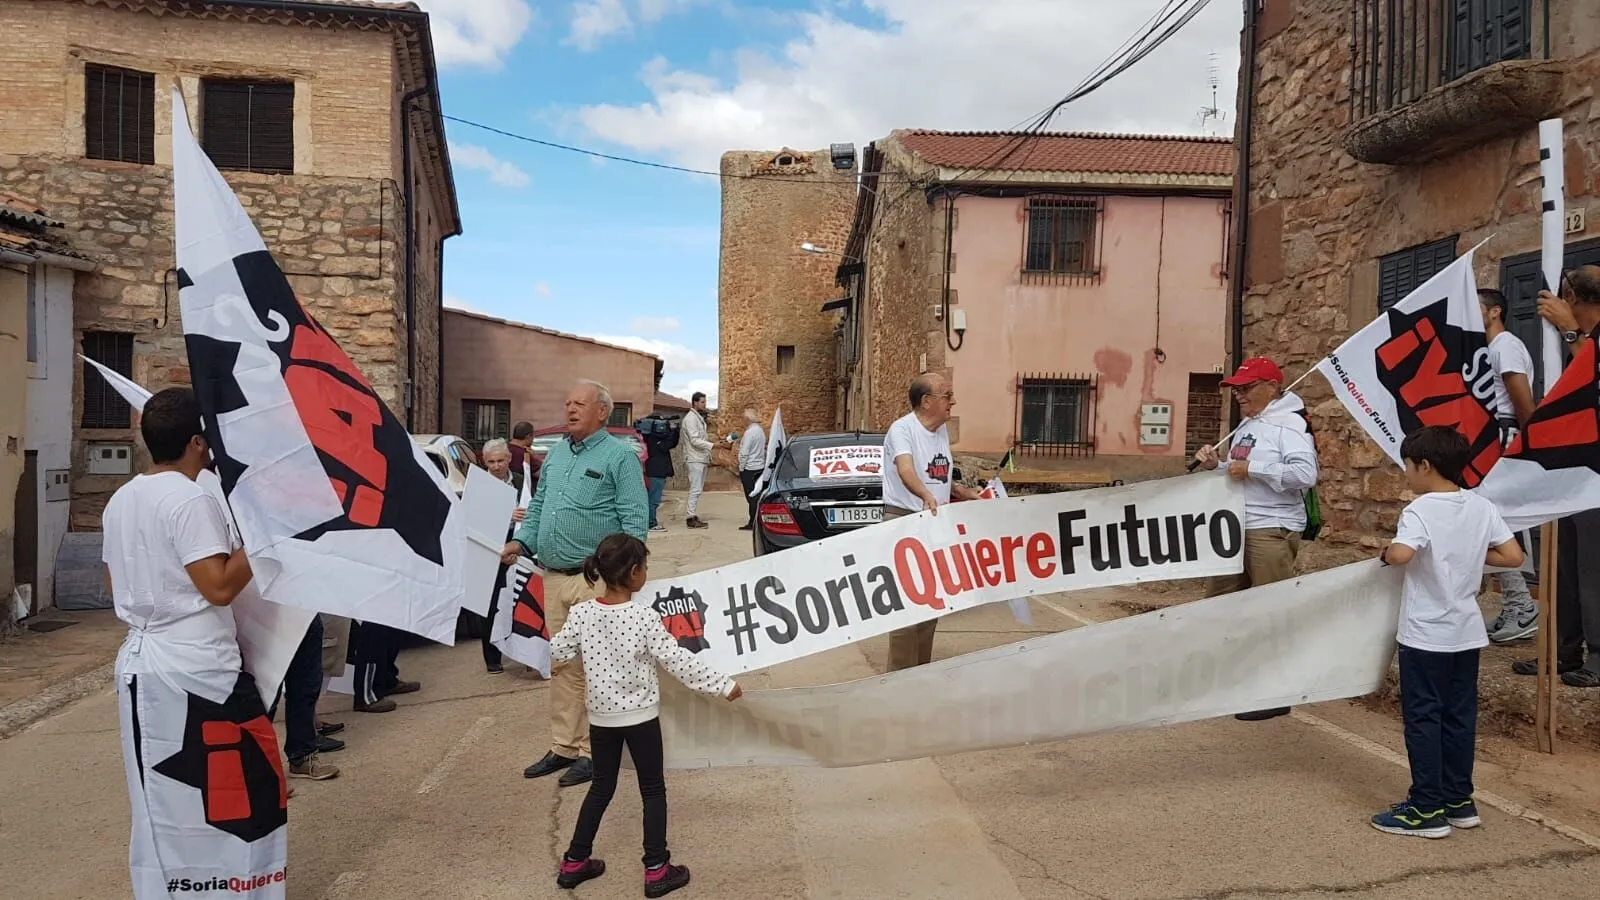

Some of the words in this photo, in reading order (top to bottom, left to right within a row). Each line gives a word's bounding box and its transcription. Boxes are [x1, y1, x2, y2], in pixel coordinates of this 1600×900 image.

[1566, 214, 1581, 232] 12
[1327, 353, 1396, 443] #SoriaQuiereFuturo
[813, 454, 842, 462] para
[814, 460, 851, 475] YA
[841, 509, 868, 521] 1183
[870, 508, 884, 520] GN
[722, 504, 1243, 656] #SoriaQuiereFuturo
[658, 596, 698, 617] SORIA
